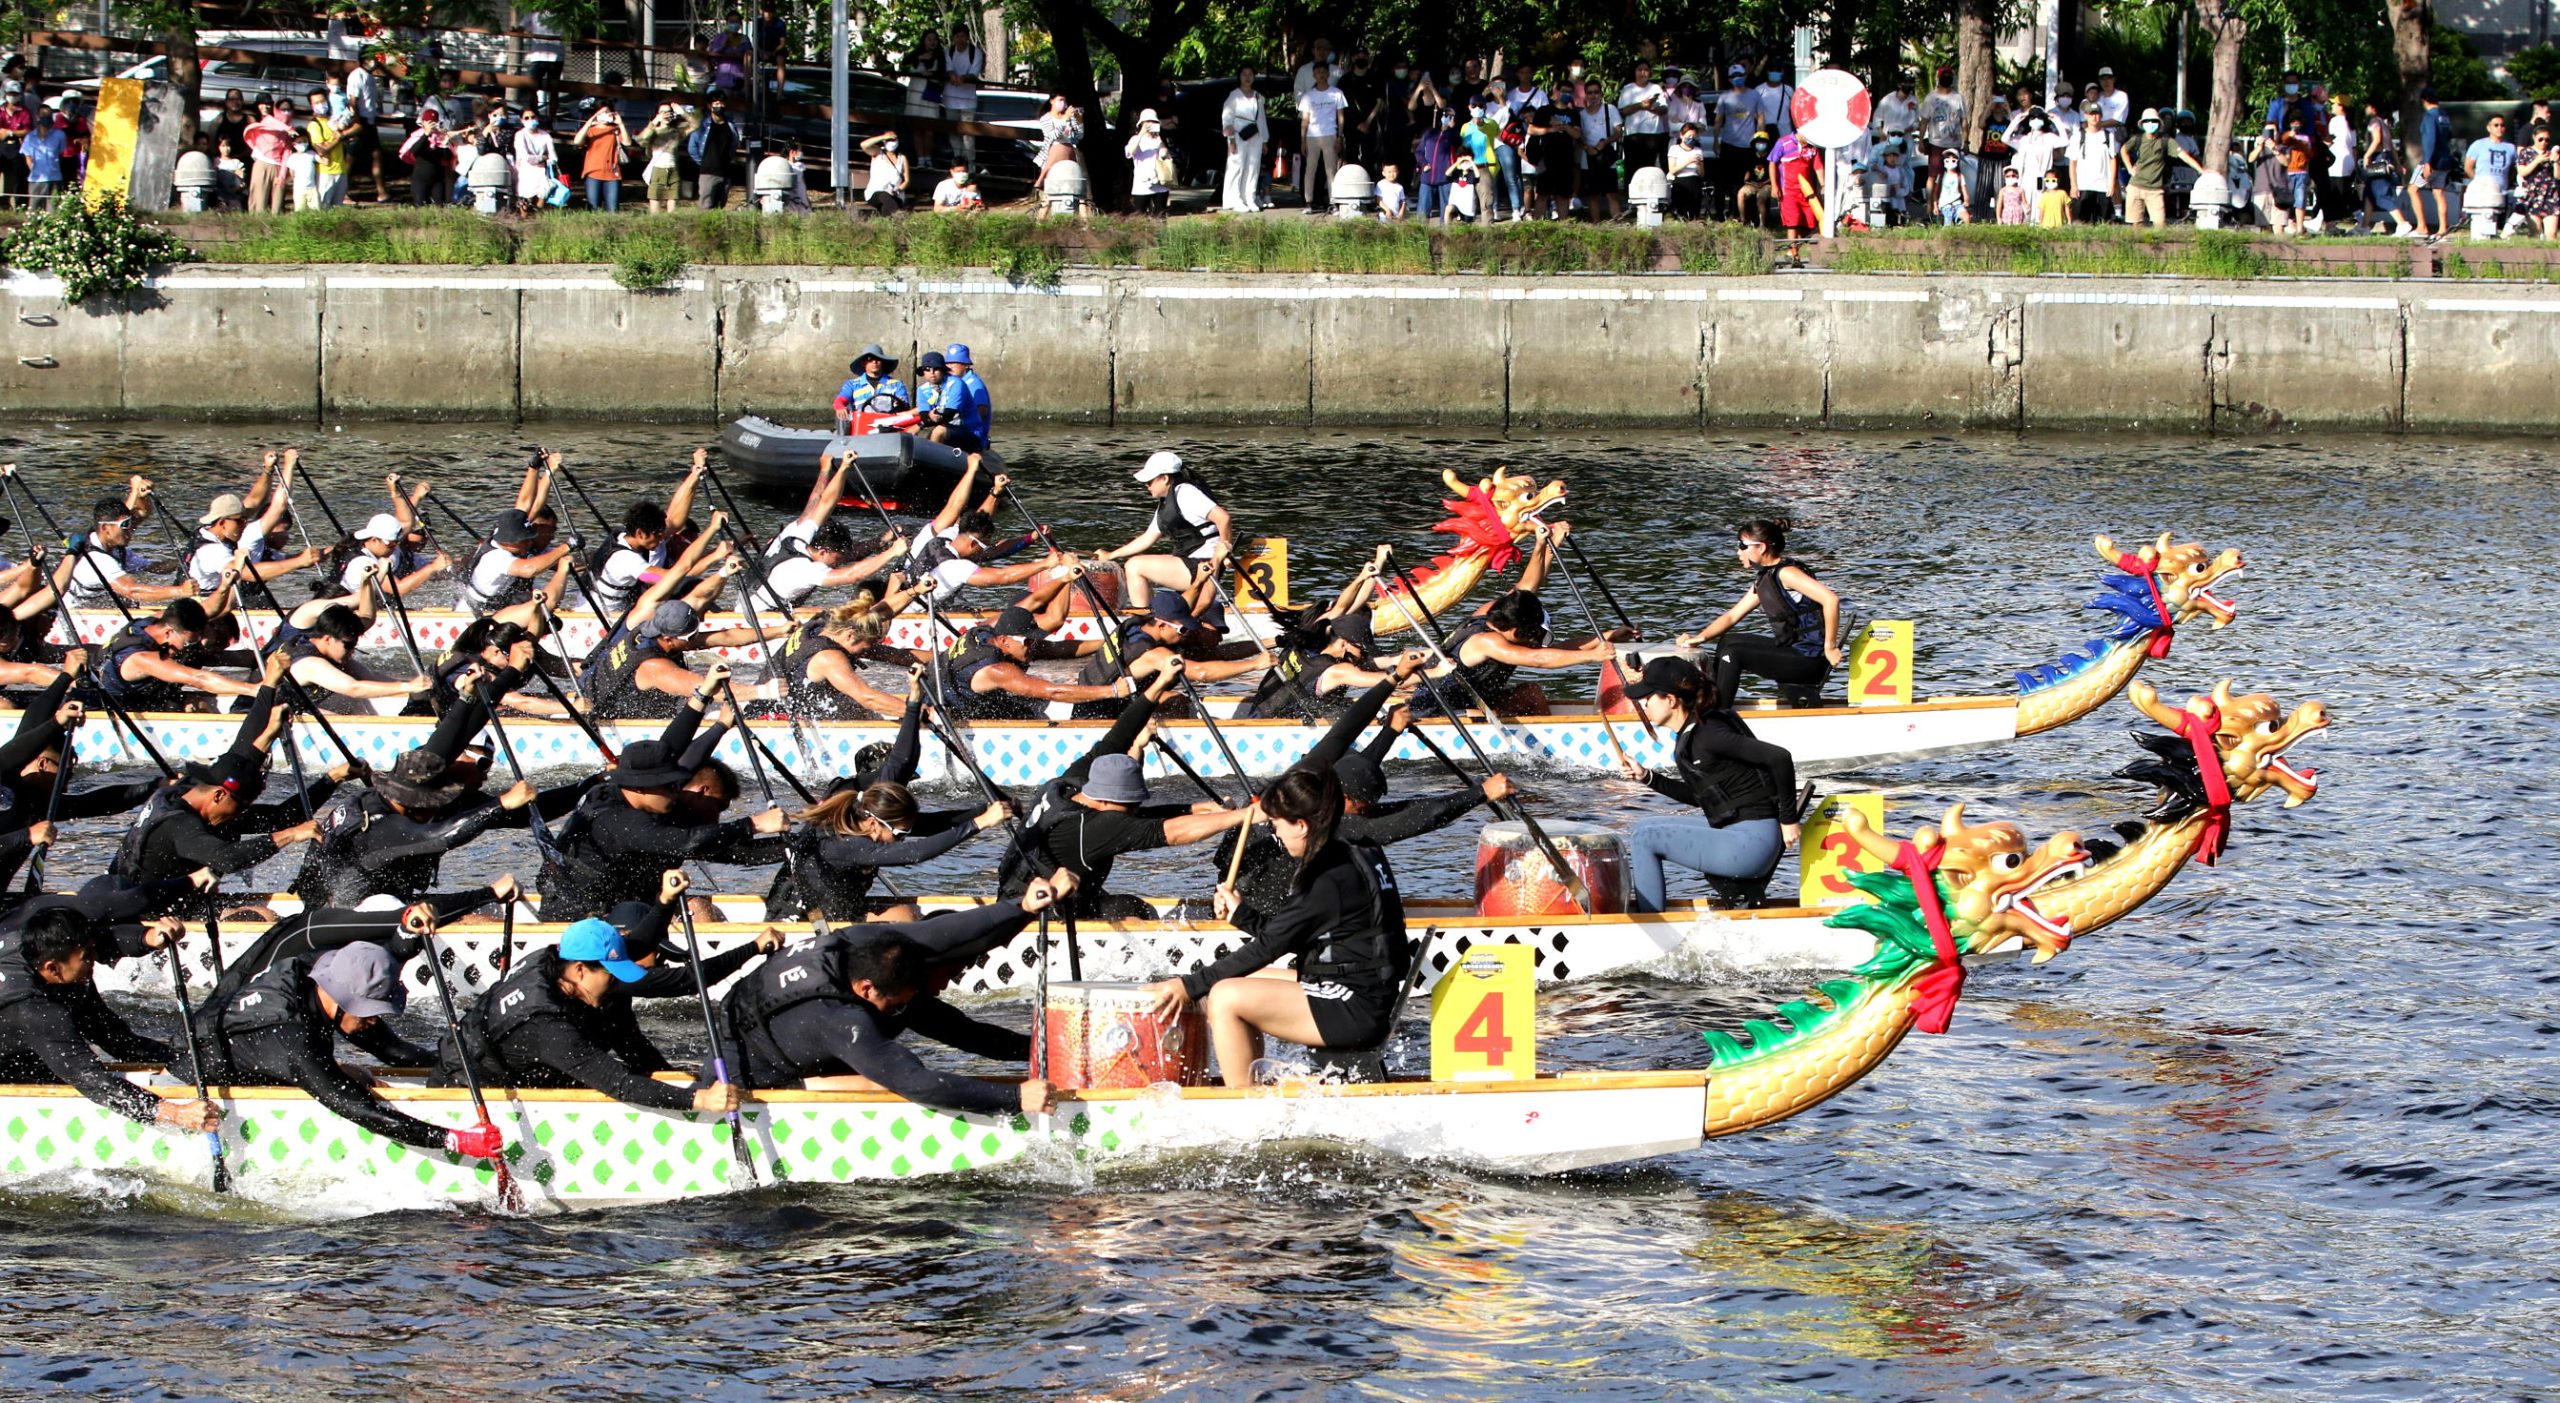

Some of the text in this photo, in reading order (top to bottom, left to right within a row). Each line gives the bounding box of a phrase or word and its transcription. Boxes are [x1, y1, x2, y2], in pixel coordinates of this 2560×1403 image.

[1247, 562, 1276, 602] 3
[1863, 649, 1898, 695] 2
[1820, 832, 1864, 893] 3
[1454, 992, 1513, 1067] 4
